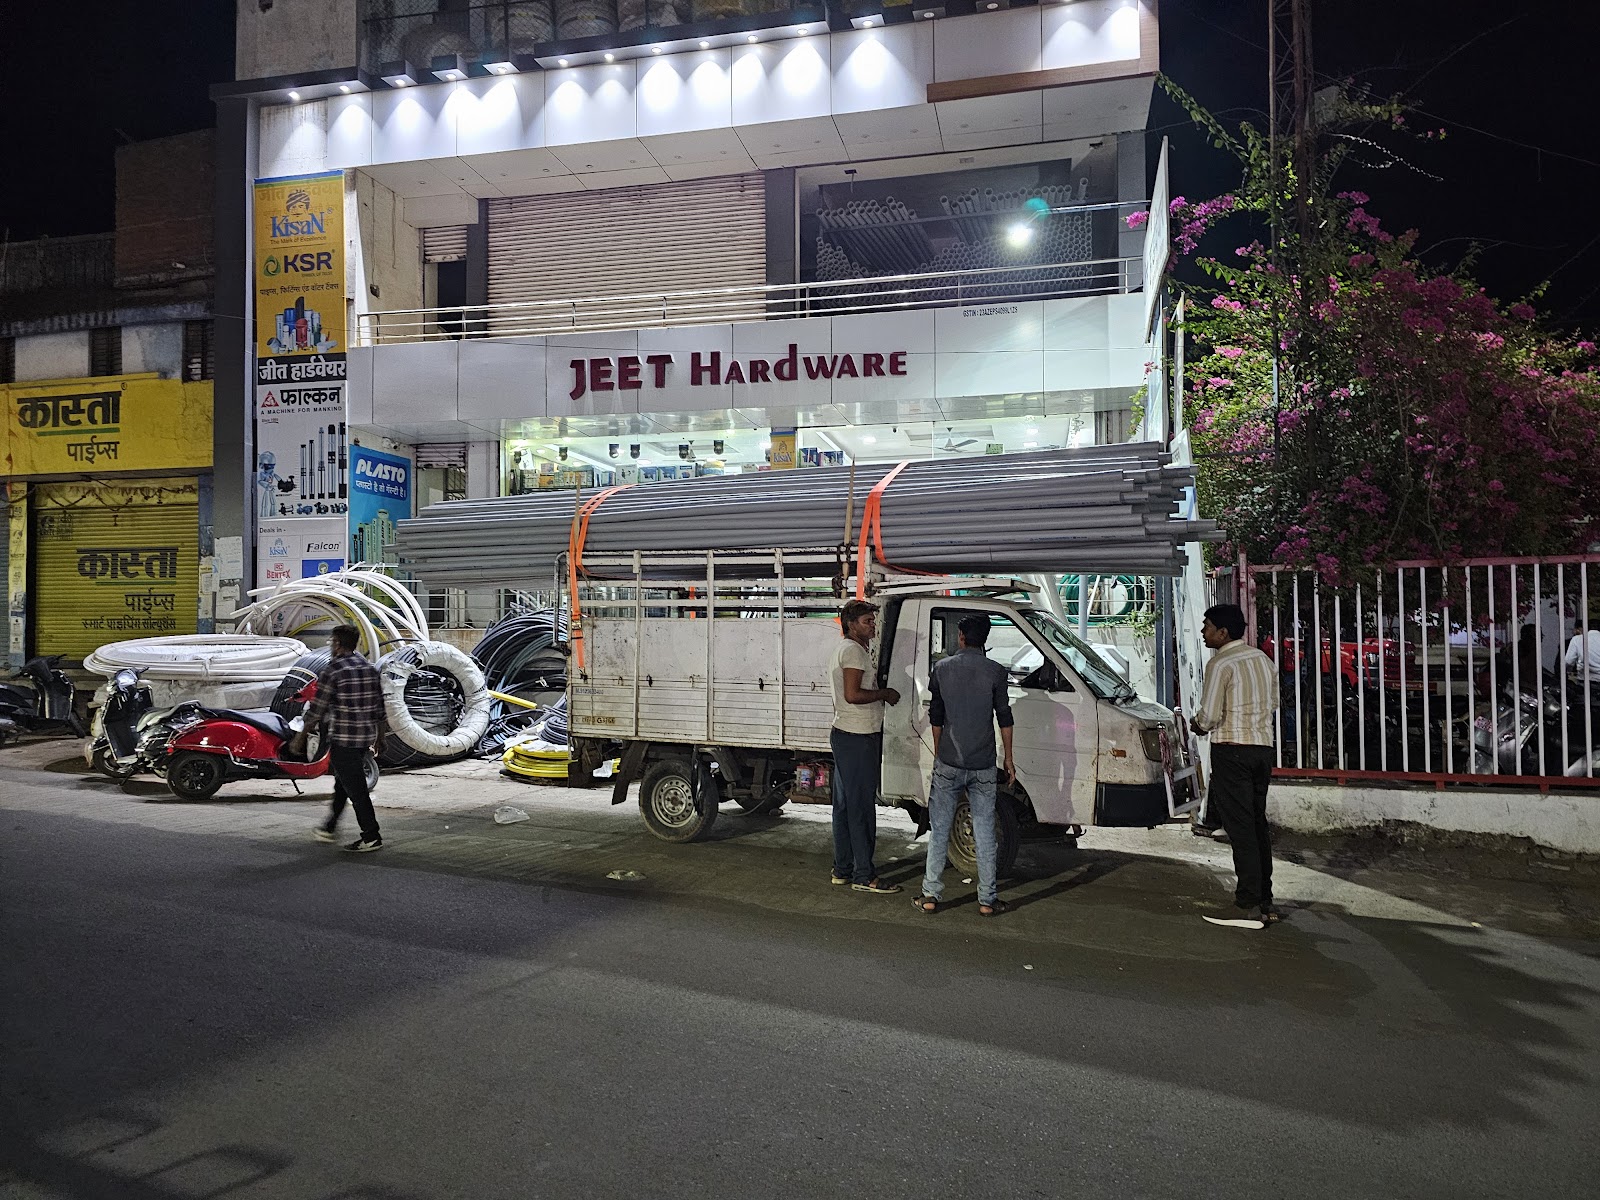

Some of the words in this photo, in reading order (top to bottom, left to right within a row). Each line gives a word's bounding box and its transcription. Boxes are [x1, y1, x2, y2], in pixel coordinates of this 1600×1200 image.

[283, 251, 333, 273] KSR
[258, 358, 288, 380] जीत
[290, 354, 347, 381] हार्डवेयर
[569, 353, 675, 400] JEET
[280, 386, 342, 406] फाल्कन
[17, 390, 123, 429] कास्ता
[66, 435, 120, 465] पाईप्स
[355, 458, 406, 484] PLASTO
[373, 480, 379, 493] है
[306, 541, 340, 553] Falcon
[76, 547, 179, 579] कास्ता
[266, 568, 291, 579] BENTEX
[124, 587, 176, 614] पाईप्स
[82, 615, 105, 630] स्मार्ट
